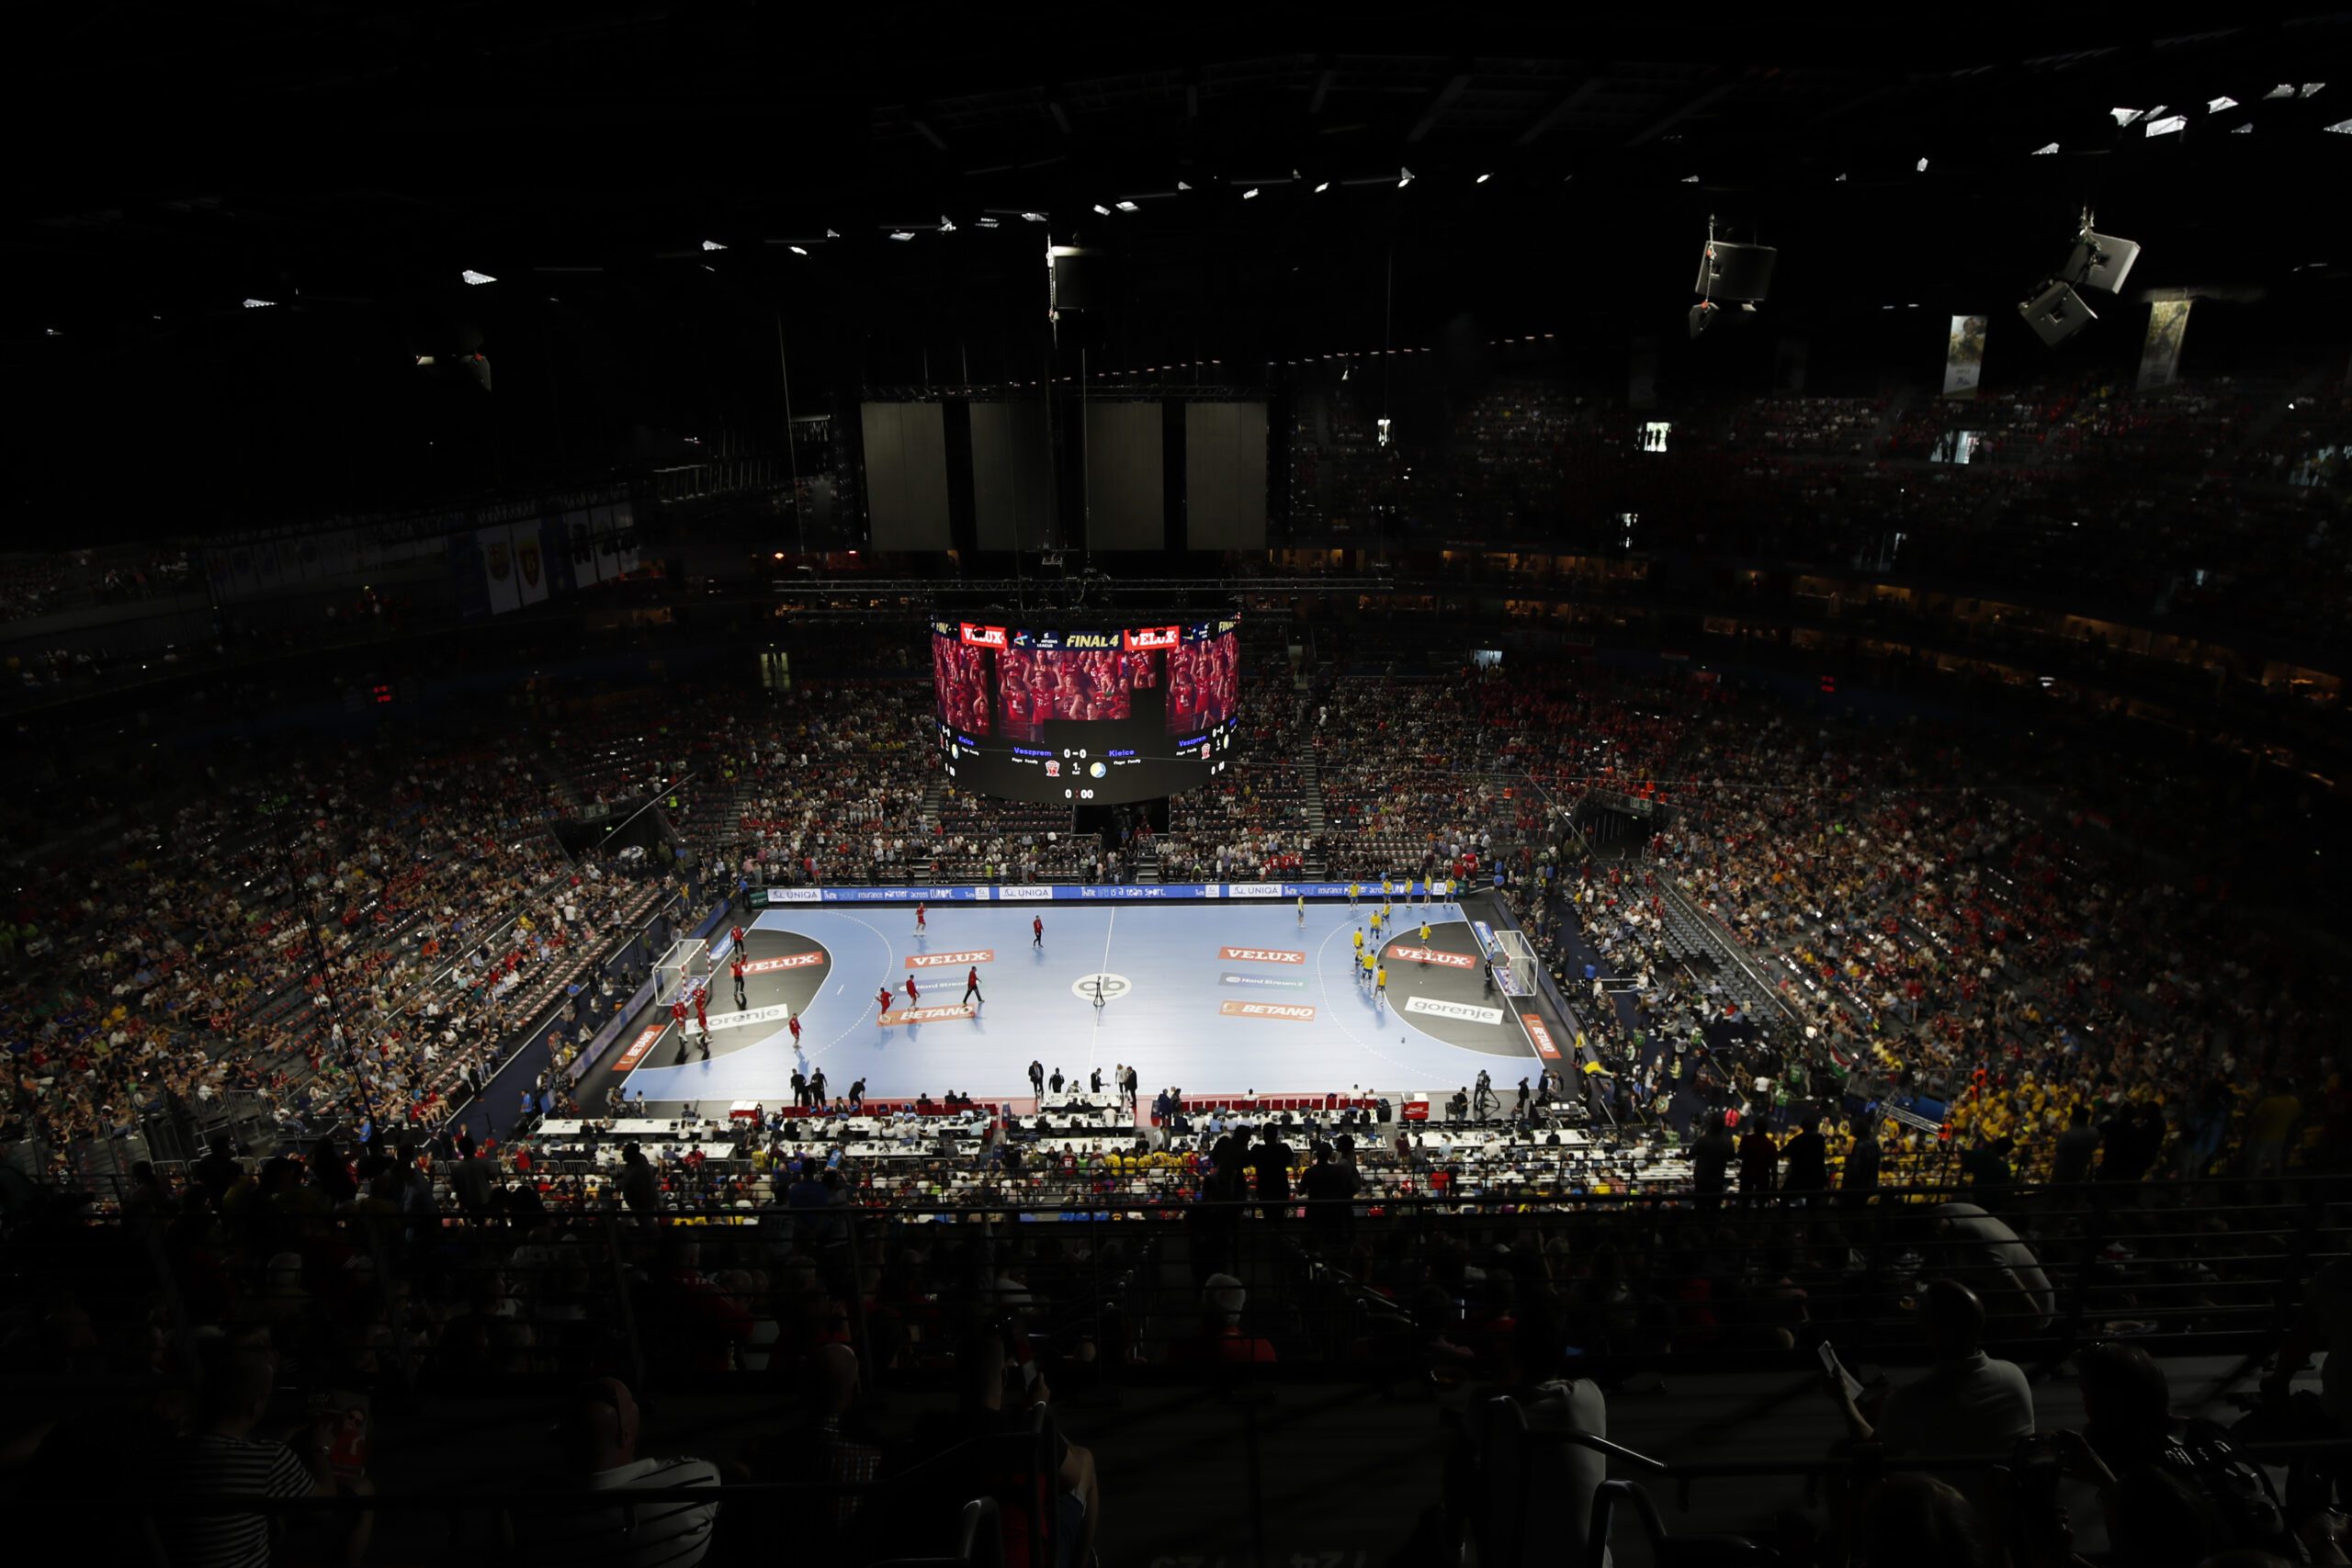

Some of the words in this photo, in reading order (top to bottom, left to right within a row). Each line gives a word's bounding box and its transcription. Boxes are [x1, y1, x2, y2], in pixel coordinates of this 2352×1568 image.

[1013, 747, 1051, 756] Veszprem
[1126, 888, 1142, 897] team
[1248, 886, 1278, 895] UNIQA
[912, 952, 989, 966] VELUX
[1227, 949, 1300, 962] VELUX
[1396, 948, 1470, 965] VELUX
[741, 955, 816, 973] VELUX
[900, 1007, 973, 1020] BETANO
[1242, 1004, 1313, 1017] BETANO
[1414, 1000, 1495, 1020] gorenje
[627, 1031, 655, 1057] BETANO
